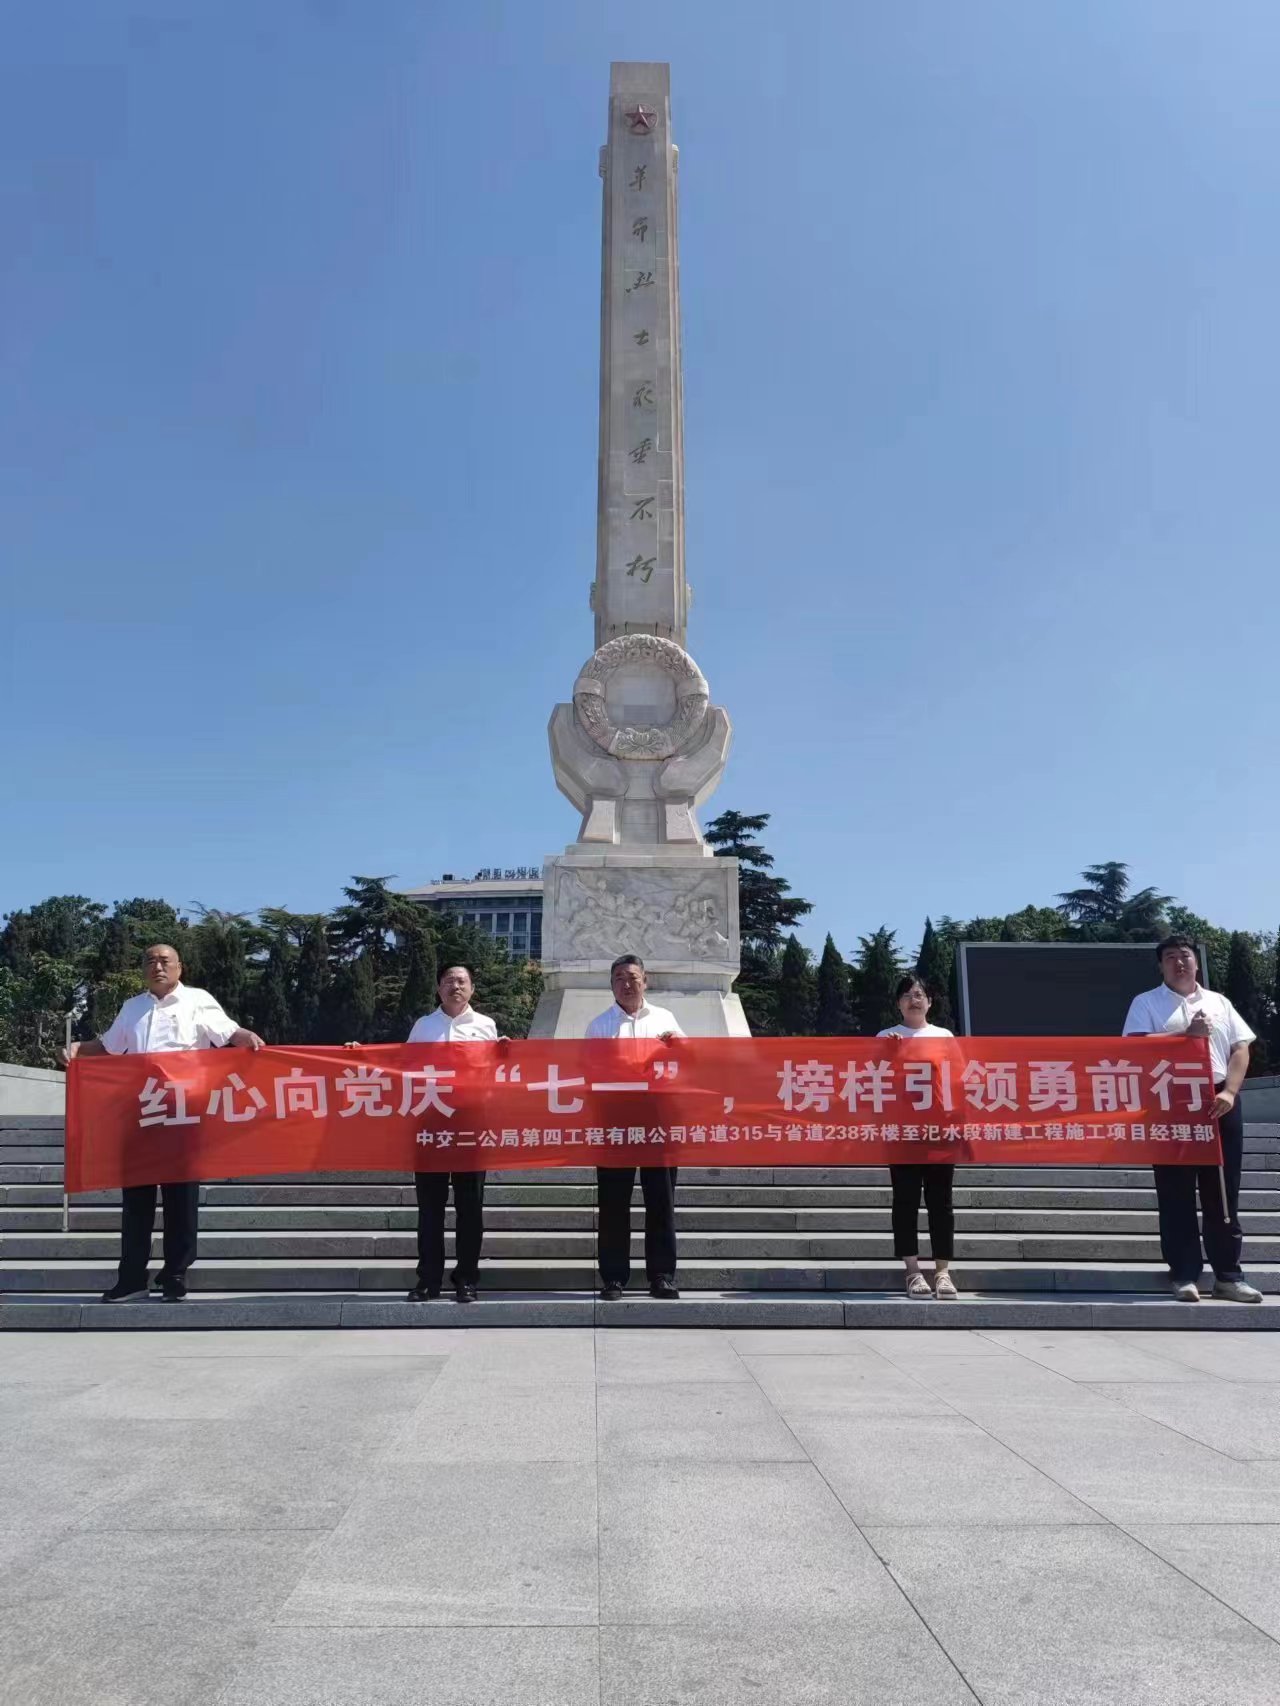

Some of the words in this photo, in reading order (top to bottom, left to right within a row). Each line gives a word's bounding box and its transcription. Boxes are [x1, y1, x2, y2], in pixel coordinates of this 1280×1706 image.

[625, 164, 657, 583] 革命烈士永垂不朽
